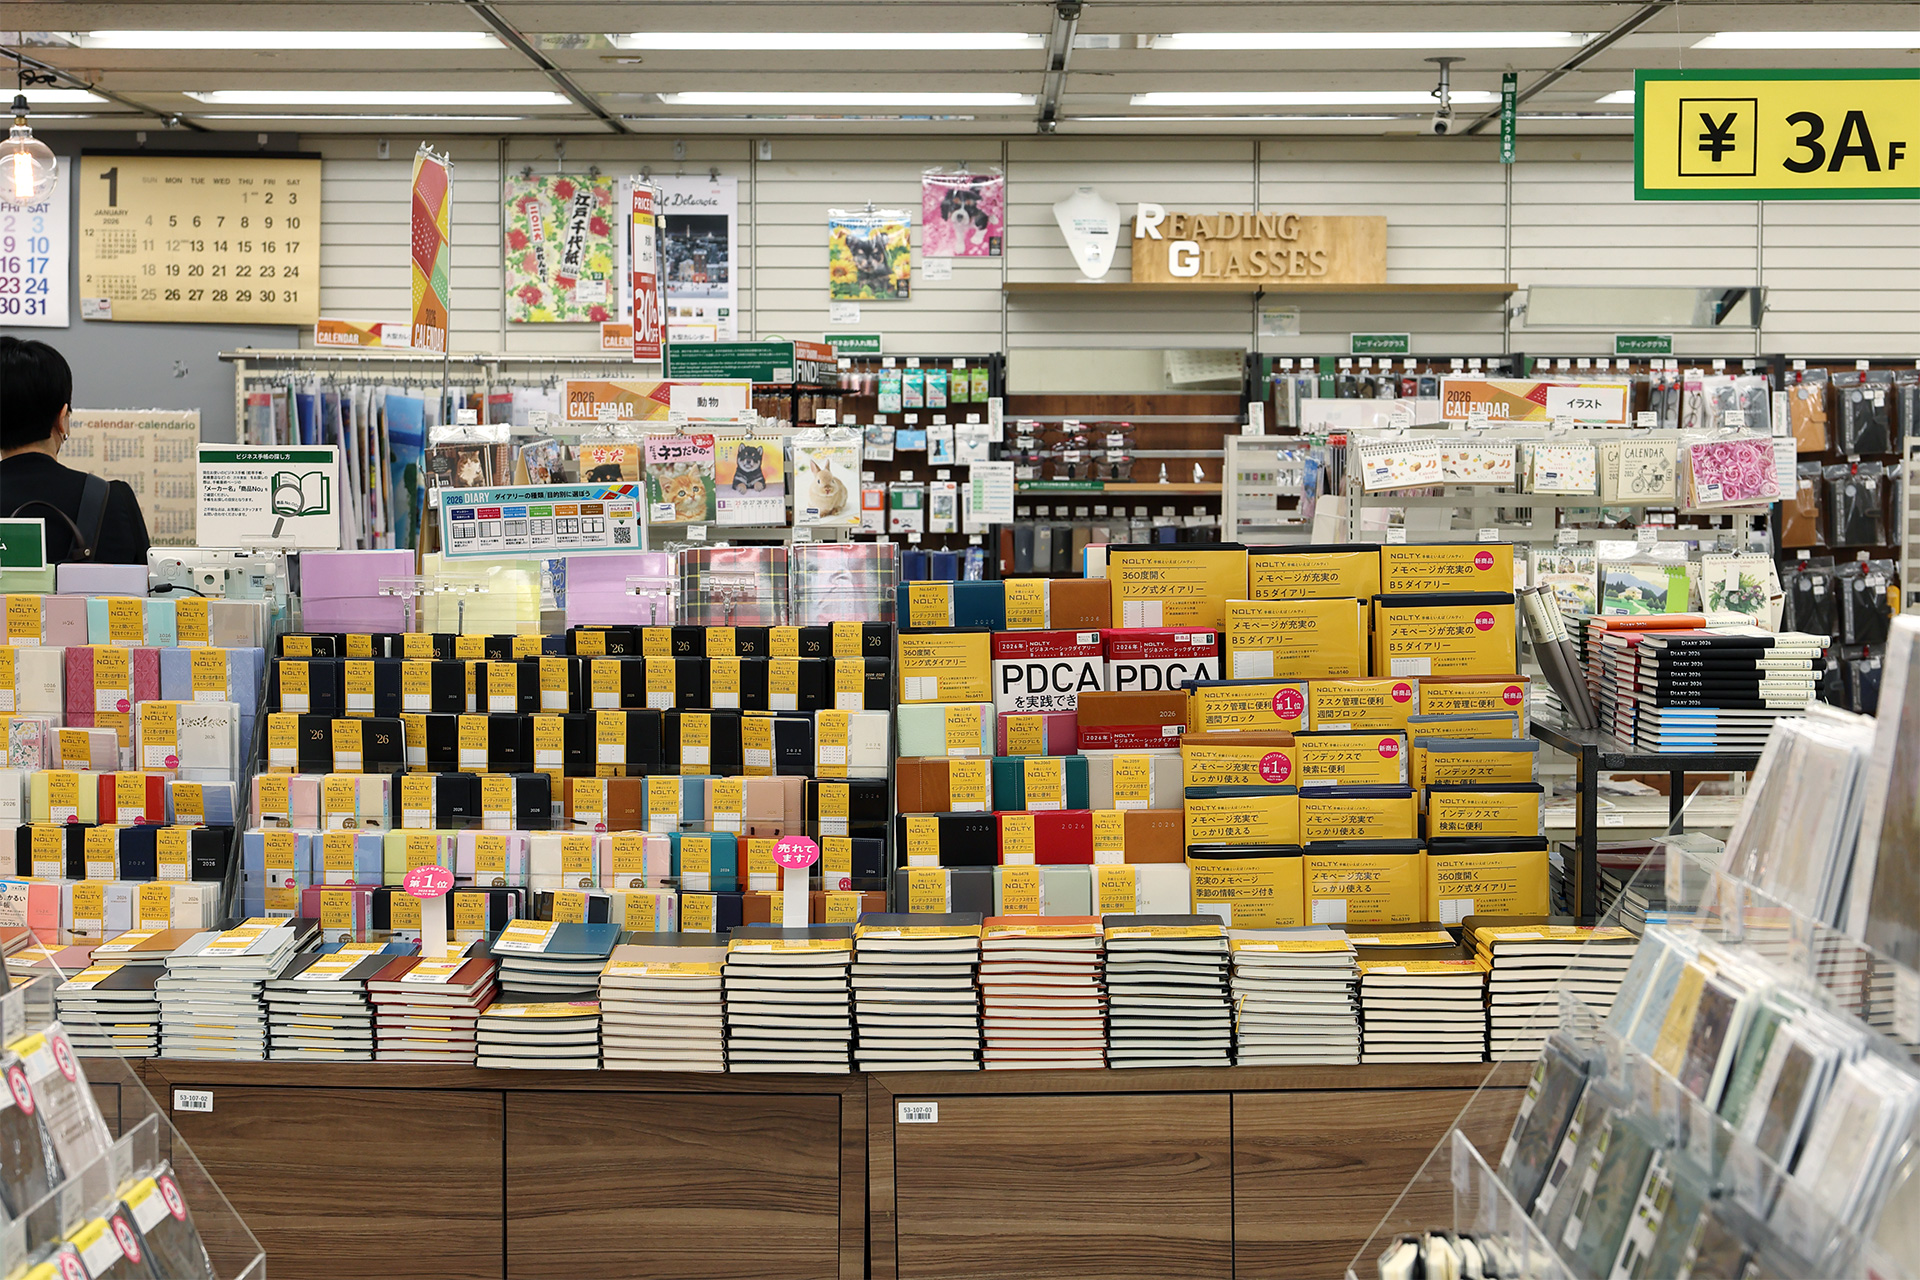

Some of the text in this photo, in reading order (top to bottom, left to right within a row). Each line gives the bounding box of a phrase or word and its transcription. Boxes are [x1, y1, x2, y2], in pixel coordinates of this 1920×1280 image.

[100, 167, 118, 207] 1
[265, 193, 297, 204] 2 3
[4, 216, 44, 232] 2 3
[169, 216, 300, 229] 5 6 7 8 9 10
[1135, 202, 1301, 240] READING
[564, 193, 591, 265] 江戸千代紙
[4, 237, 49, 254] 9 10
[190, 240, 299, 253] 13 14 15 16 17
[1169, 240, 1328, 277] GLASSES
[0, 257, 48, 274] 16 17
[166, 265, 299, 278] 19 20 21 22 23 24
[25, 278, 49, 295] 24
[165, 289, 298, 302] 26 27 28 29 30 31
[25, 299, 46, 315] 31
[318, 332, 359, 344] CALENDAR
[414, 324, 445, 352] CALENDAR
[650, 328, 659, 343] OFF
[1355, 339, 1406, 348] リーディンググラス
[1617, 339, 1668, 348] リーディンググラス
[796, 360, 820, 383] FIND!
[570, 392, 595, 403] 2026
[696, 396, 719, 408] 動物
[1448, 391, 1471, 402] 2026
[1567, 398, 1602, 409] イラスト
[570, 401, 633, 418] CALENDAR
[1446, 402, 1510, 418] CALENDAR
[592, 448, 624, 462] 柴犬
[1624, 448, 1665, 459] CALENDAR
[464, 493, 489, 504] DIARY
[1391, 565, 1473, 574] メモページが充実の
[1123, 571, 1166, 580] 360度開く
[1257, 572, 1338, 583] メモページが充実の
[1123, 586, 1204, 594] リング式ダイアリー
[1390, 580, 1450, 589] B5ダイアリー
[1256, 589, 1316, 598] B5ダイアリー
[1233, 621, 1316, 630] メモページが充実の
[1390, 626, 1474, 636] メモページが充実の
[1232, 635, 1293, 644] B5ダイアリー
[1390, 642, 1451, 651] B5ダイアリー
[1003, 662, 1100, 694] PDCA
[1116, 663, 1211, 690] PDCA
[1206, 701, 1272, 710] タスク管理に便利
[1276, 697, 1301, 710] 第1位
[1317, 696, 1384, 706] タスク管理に便利
[1428, 700, 1495, 708] タスク管理に便利
[1317, 709, 1366, 718] 週間ブロック
[1206, 715, 1255, 724] 週間ブロック
[1303, 753, 1361, 761] インデックスで
[1263, 761, 1288, 774] 第1位
[1303, 765, 1345, 773] 検索に便利
[1192, 827, 1250, 836] しっかり使える
[1440, 822, 1482, 830] 検索に便利
[777, 844, 816, 854] 売れて
[409, 874, 448, 888] 第1位
[1196, 876, 1259, 884] 充実のメモページ
[1438, 872, 1478, 880] 360度開く
[1196, 888, 1274, 897] 季節の情報ページ付き
[1439, 884, 1516, 893] リング式ダイアリー
[180, 1094, 208, 1102] 53-107-02
